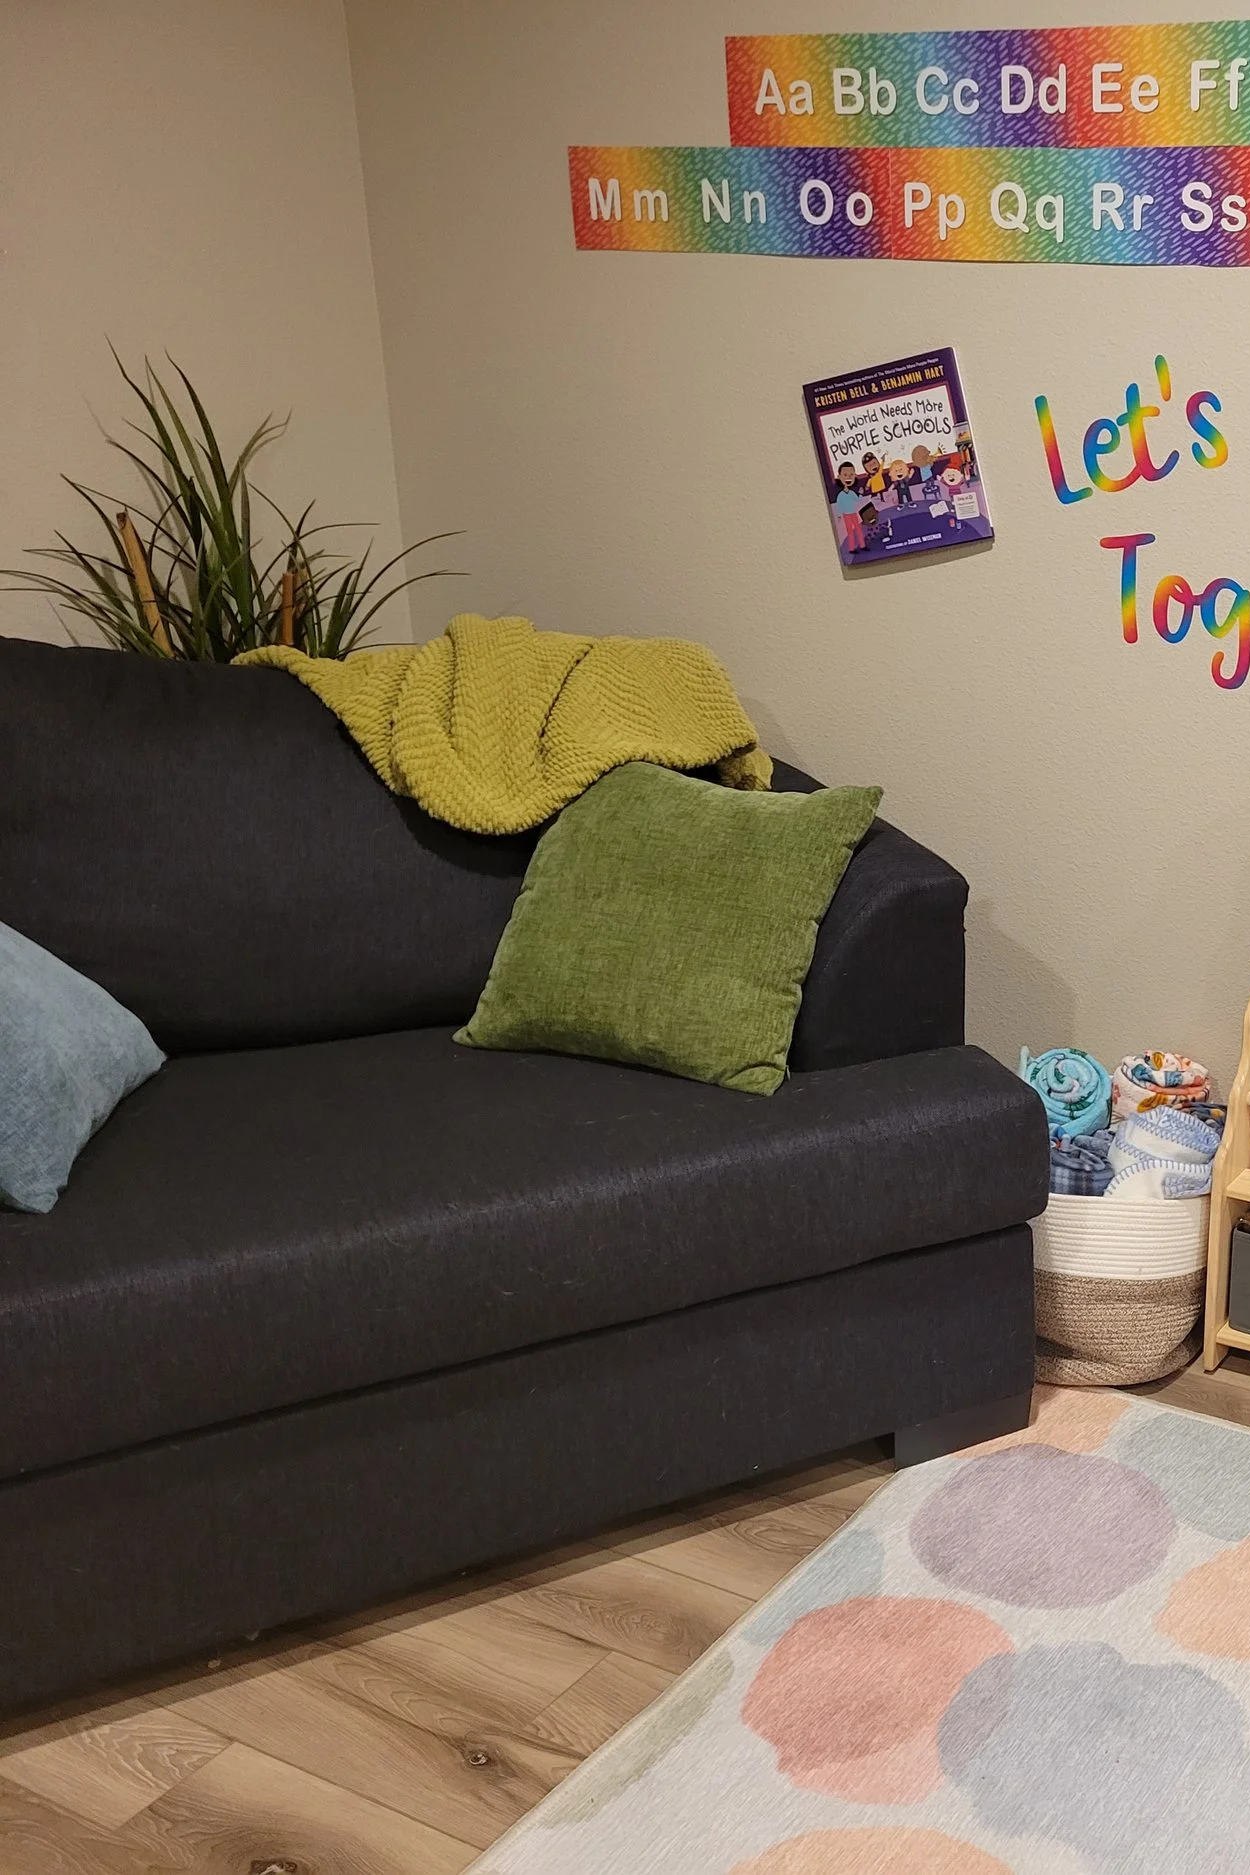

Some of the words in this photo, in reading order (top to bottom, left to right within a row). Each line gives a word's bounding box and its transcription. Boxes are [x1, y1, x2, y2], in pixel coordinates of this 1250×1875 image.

[814, 389, 848, 408] KRISTEN
[849, 385, 869, 400] BELL
[871, 382, 880, 393] &
[880, 371, 922, 390] BENJAMIN
[924, 365, 945, 380] HART
[828, 424, 845, 438] The
[846, 409, 878, 431] World
[916, 399, 943, 414] More
[830, 428, 880, 462] PURPLE
[883, 416, 952, 442] SCHOOLS
[1034, 354, 1229, 505] Let's
